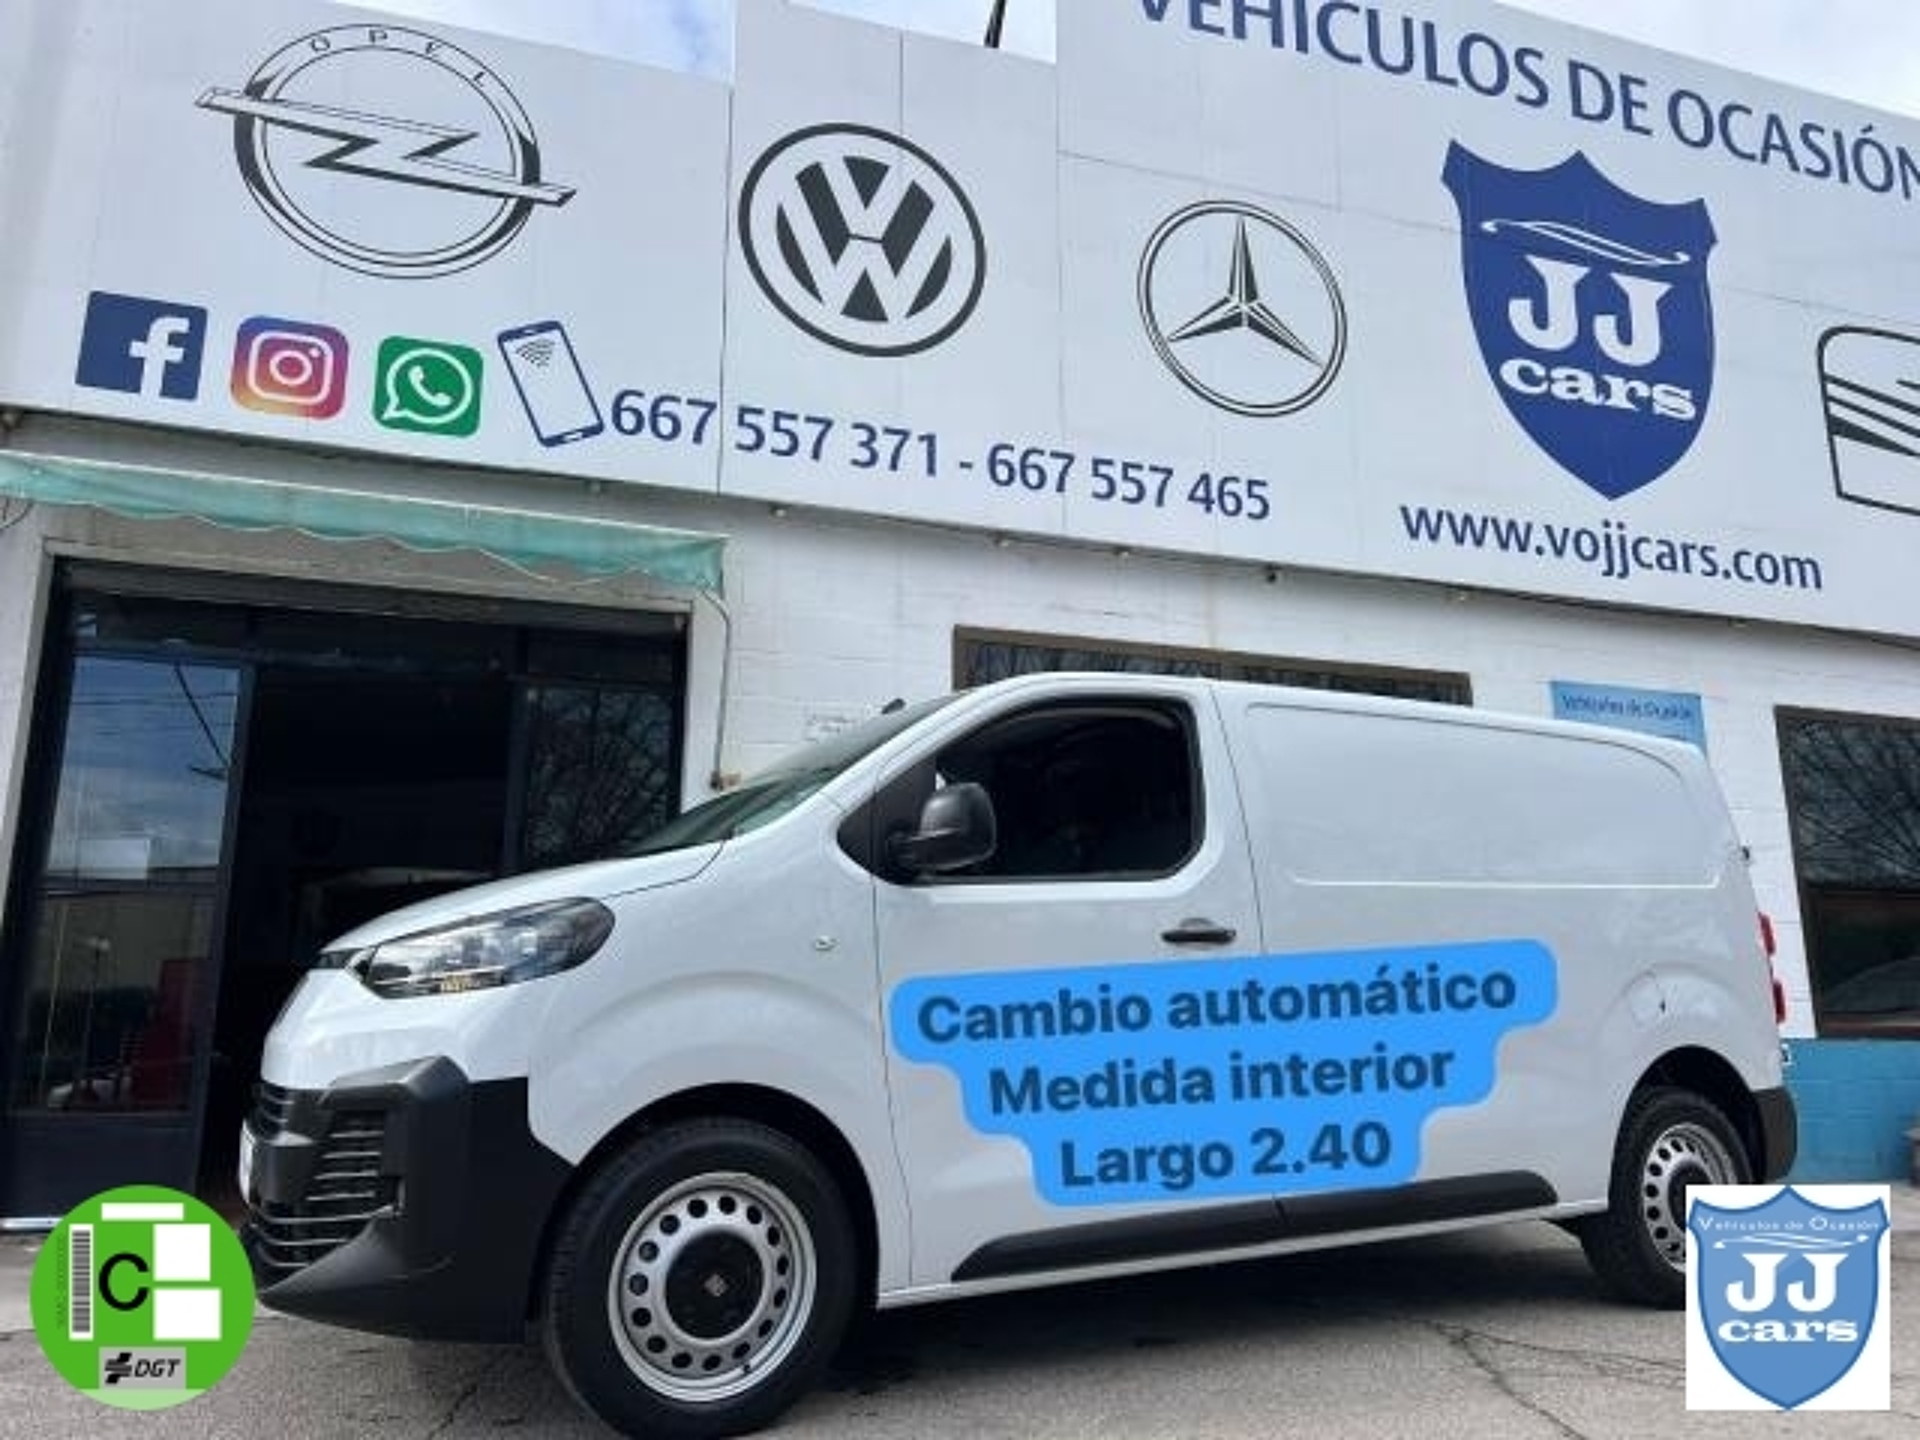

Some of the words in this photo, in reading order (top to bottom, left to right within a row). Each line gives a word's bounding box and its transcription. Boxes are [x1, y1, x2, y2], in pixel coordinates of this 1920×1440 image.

[310, 28, 486, 88] OPEL
[1568, 59, 1653, 136] DE
[1668, 89, 1920, 200] OCASIÓN
[1508, 254, 1674, 367] JJ
[1499, 358, 1697, 421] cars
[610, 389, 718, 445] 667
[735, 405, 836, 461] 557
[849, 422, 938, 477] 371
[988, 443, 1075, 494] 667
[1090, 457, 1175, 507] 557
[1187, 472, 1271, 520] 465
[1400, 505, 1822, 590] www.vojjcars.com
